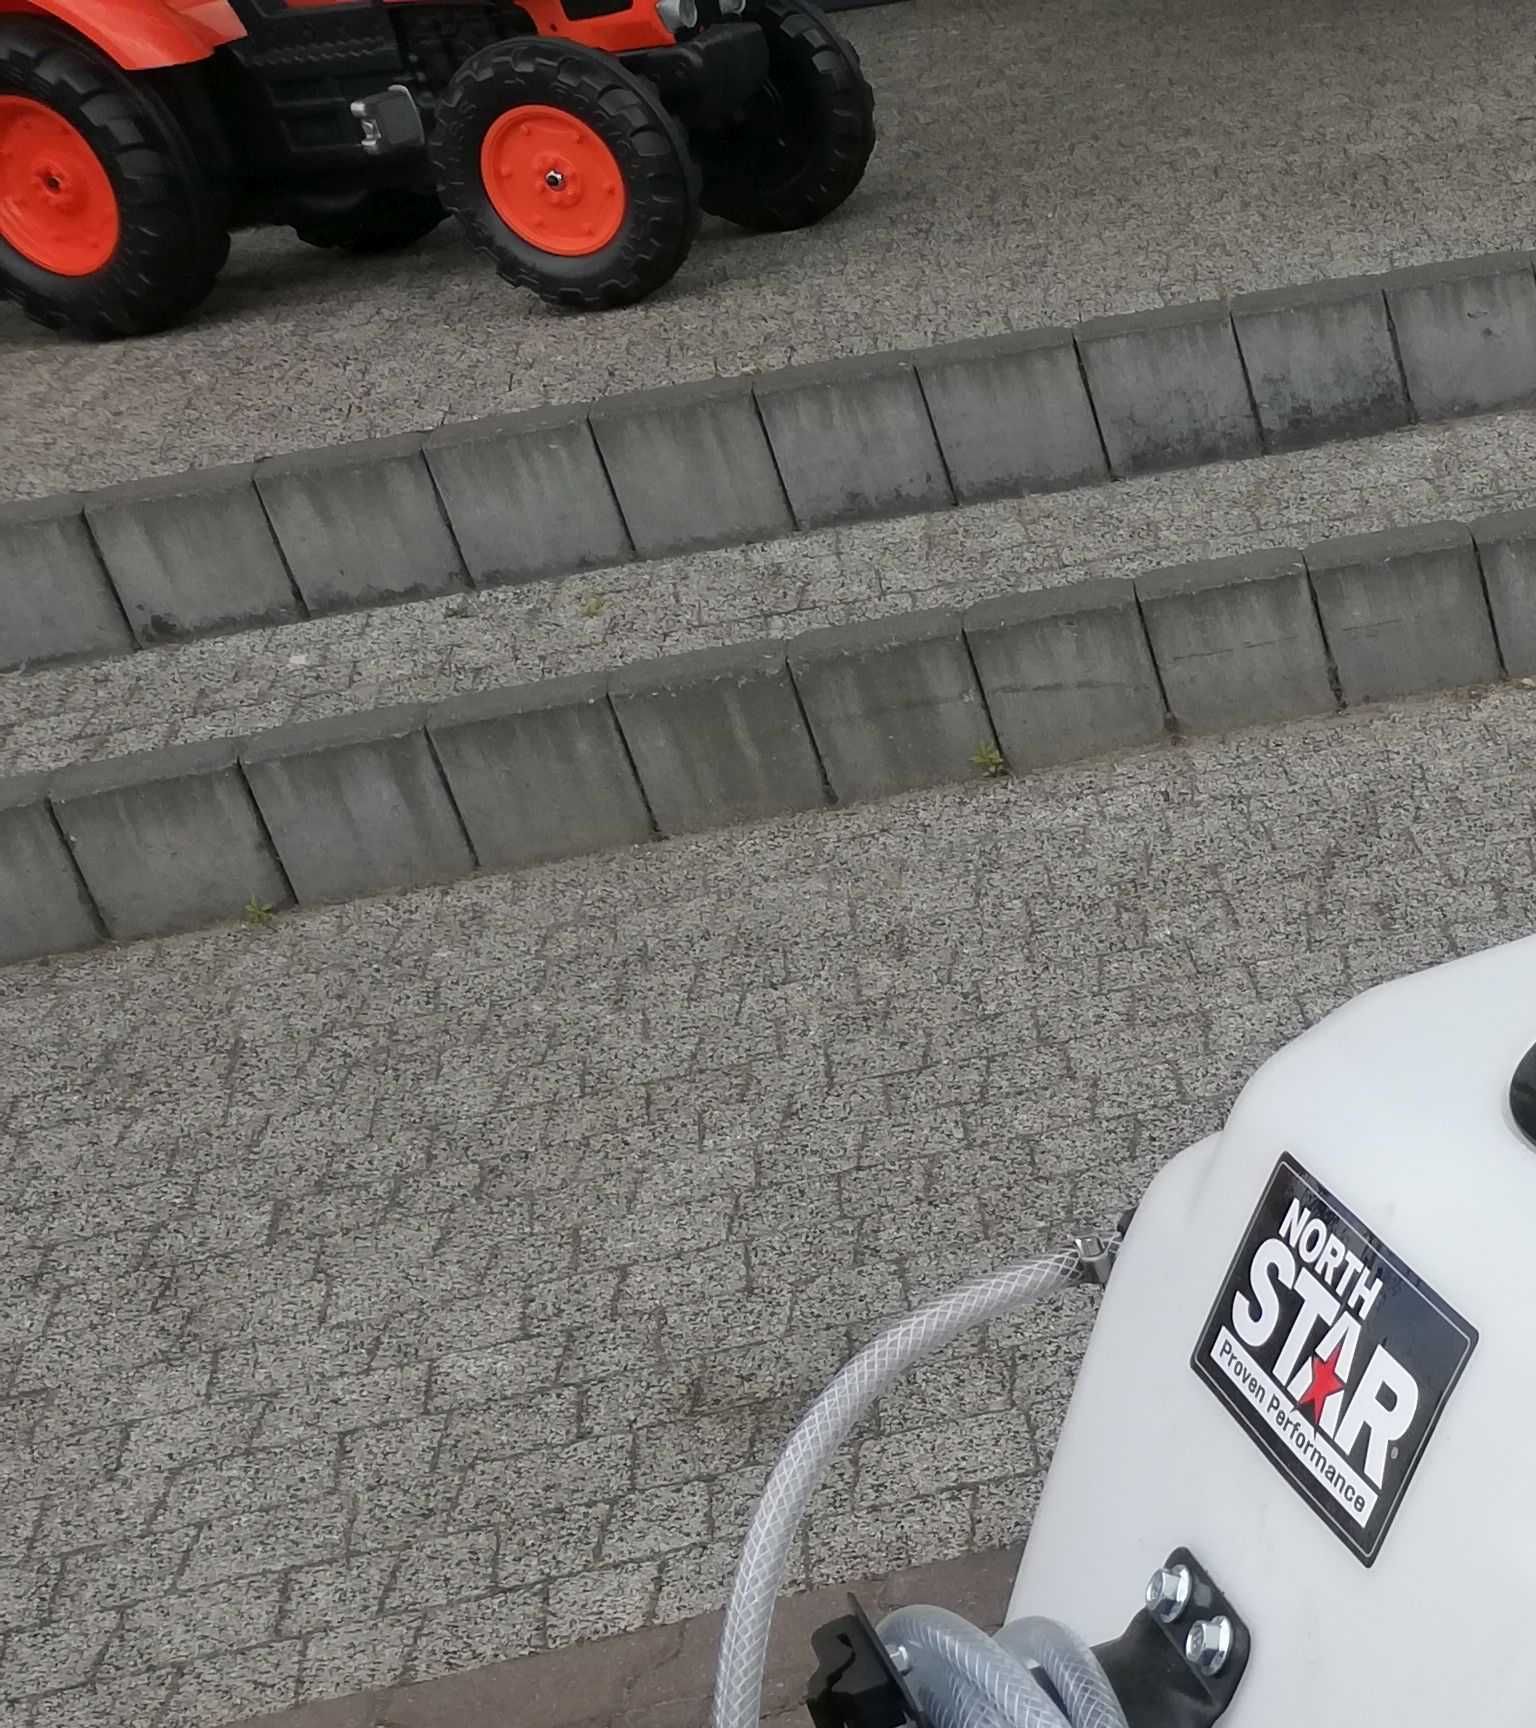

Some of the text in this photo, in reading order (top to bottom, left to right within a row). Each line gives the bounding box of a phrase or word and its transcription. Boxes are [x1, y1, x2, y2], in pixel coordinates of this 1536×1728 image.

[1278, 1197, 1384, 1320] NORTH
[1219, 1339, 1366, 1513] Proven Performance
[1232, 1238, 1419, 1490] STAR
